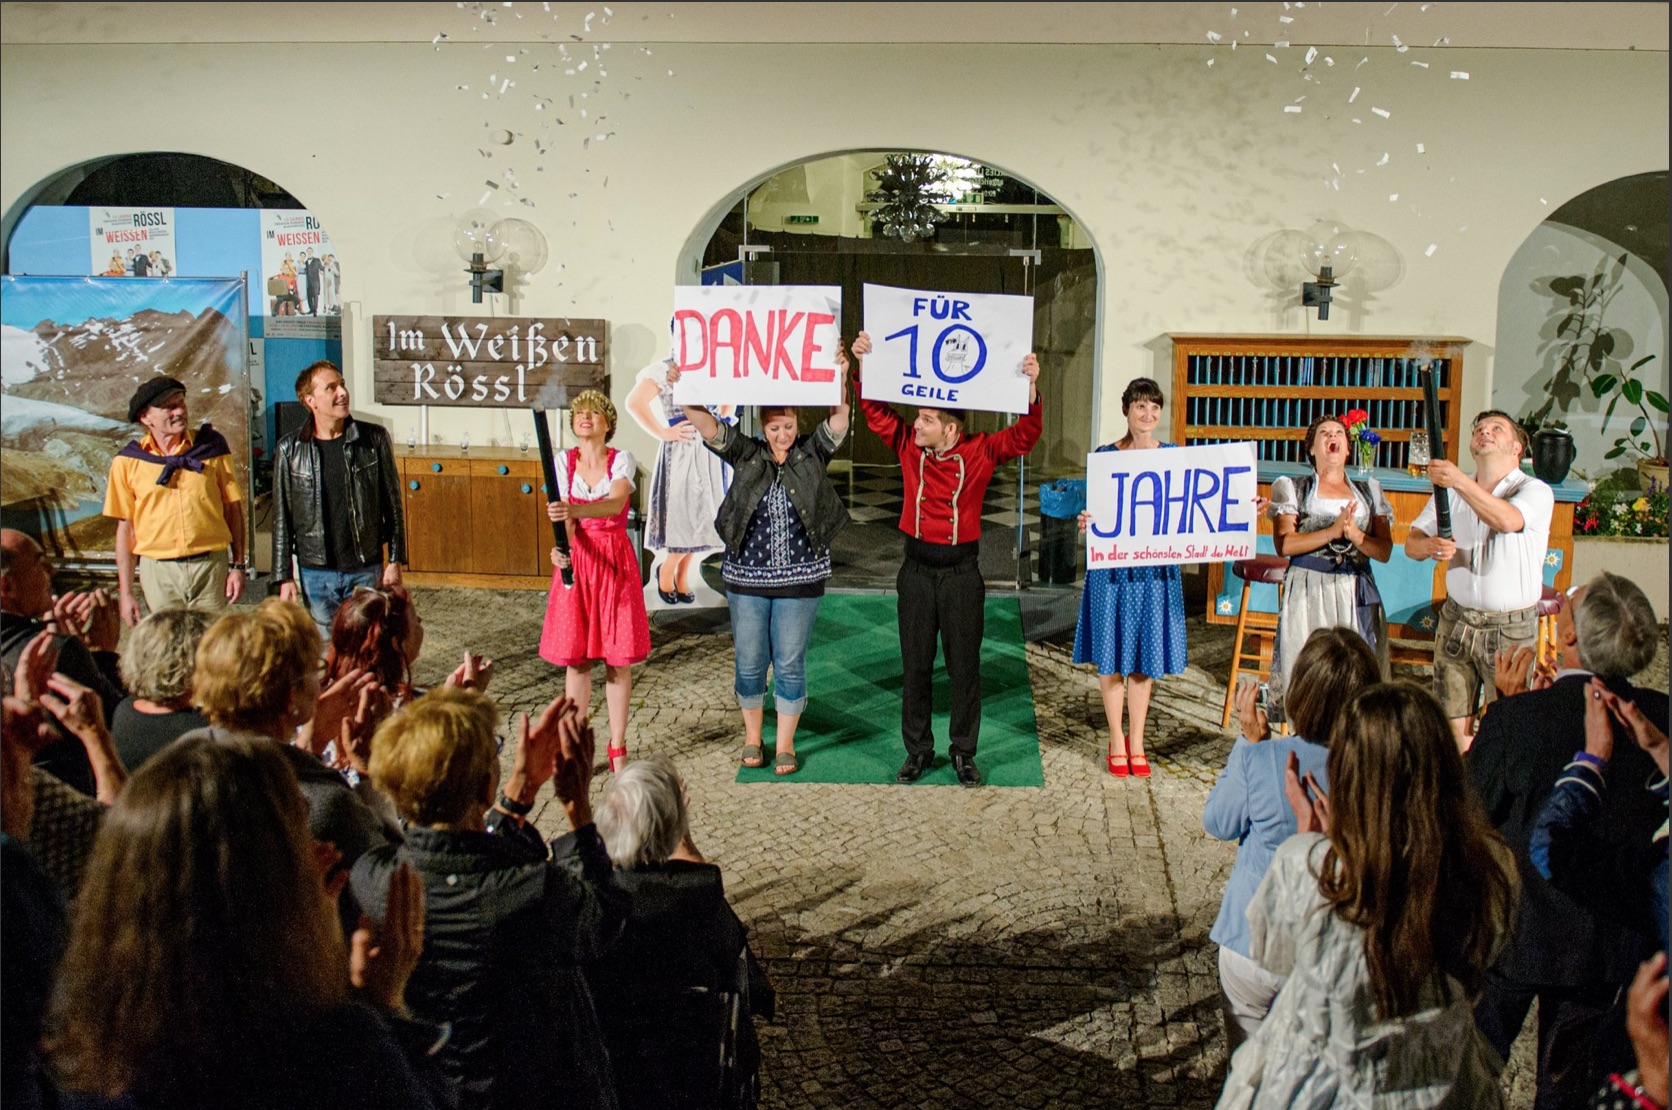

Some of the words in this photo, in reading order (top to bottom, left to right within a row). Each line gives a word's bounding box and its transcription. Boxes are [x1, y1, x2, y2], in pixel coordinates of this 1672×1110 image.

[133, 211, 167, 227] RÖSSL
[95, 227, 104, 236] IM
[106, 229, 148, 243] WEISSEN
[266, 230, 275, 239] IM
[277, 231, 321, 246] WEISSEN
[913, 295, 973, 321] FÜR
[388, 321, 426, 352] Im
[440, 322, 599, 371] Weißen
[674, 308, 836, 383] DANKE
[885, 323, 988, 384] 10
[410, 362, 528, 403] Rössl
[901, 384, 959, 402] GEILE
[1091, 466, 1251, 538] JAHRE
[1090, 546, 1105, 562] In
[1107, 544, 1129, 561] der
[1132, 545, 1182, 560] schönsten
[1184, 544, 1209, 559] Stadt
[1211, 545, 1224, 558] der
[1224, 544, 1250, 558] Welt
